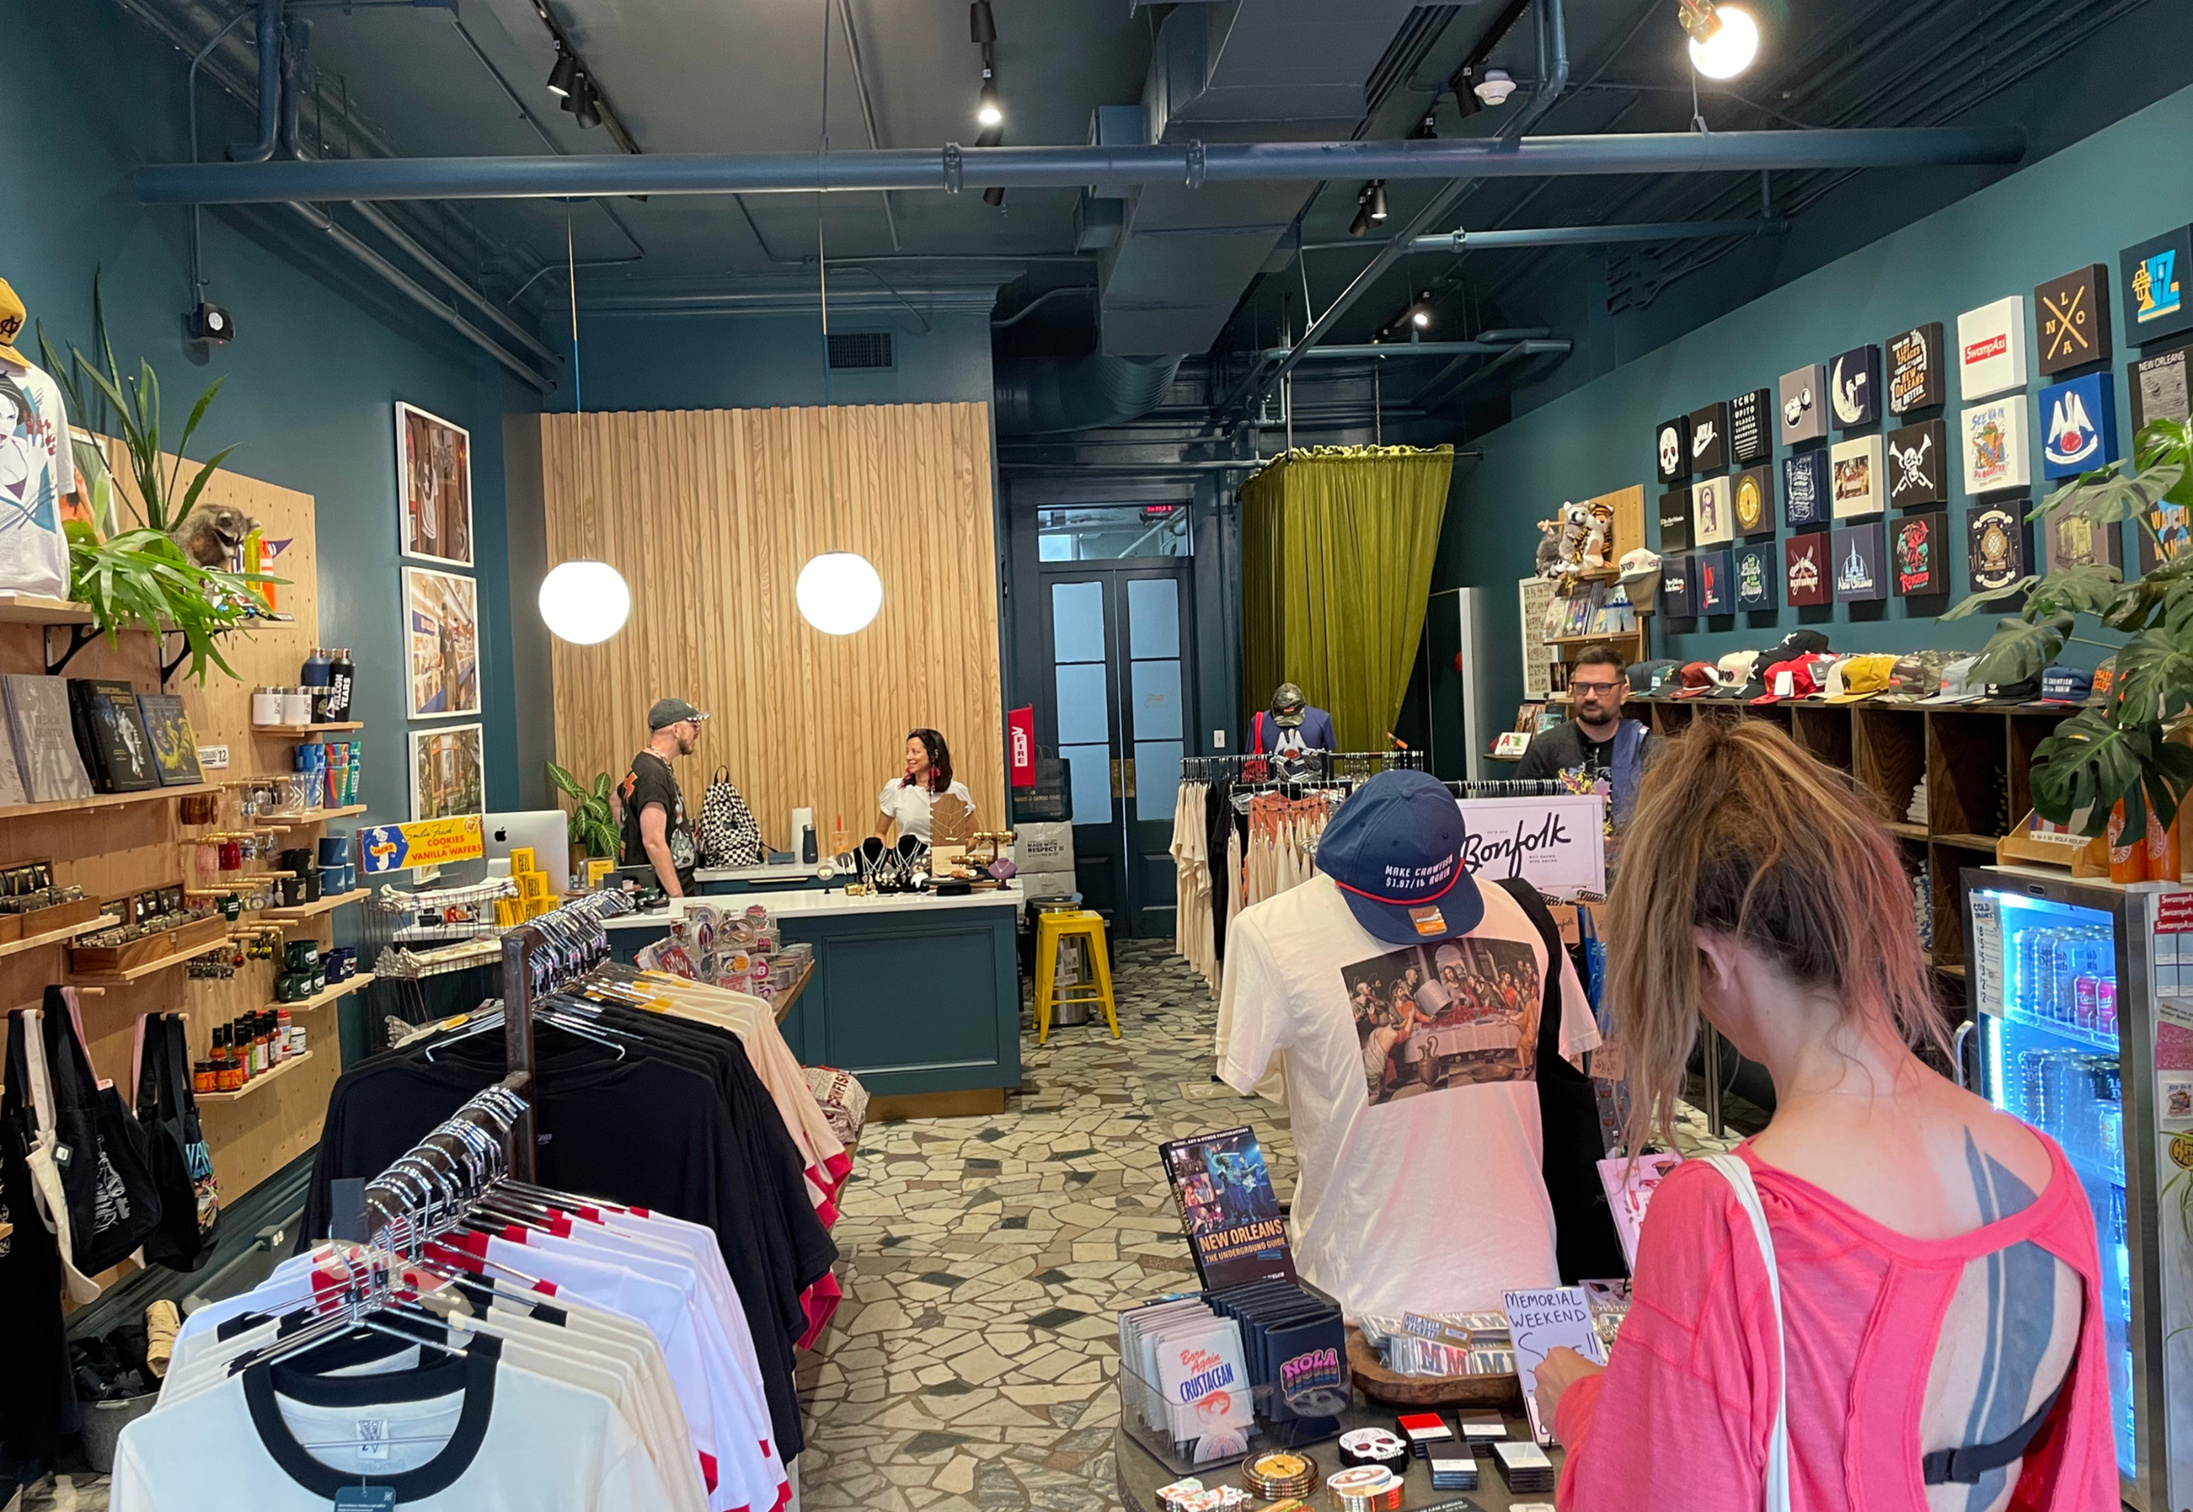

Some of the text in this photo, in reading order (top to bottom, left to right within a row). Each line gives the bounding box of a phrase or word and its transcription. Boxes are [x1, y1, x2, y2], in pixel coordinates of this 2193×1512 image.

[1966, 336, 2006, 360] SwampAss
[2138, 350, 2186, 372] NEW ORLEANS
[1895, 372, 1925, 399] ORLEANS
[1901, 367, 1917, 384] NEW
[1733, 392, 1756, 408] TCHO
[1971, 412, 1987, 431] SEE
[334, 674, 343, 711] FALCON
[341, 677, 351, 708] TEARS
[1016, 736, 1025, 764] FIRE
[411, 844, 482, 861] VANILLA WAFERS
[427, 835, 465, 847] COOKIES
[1463, 812, 1572, 878] Bonfolk
[1385, 853, 1453, 877] MAKE CRAWFISH
[1973, 903, 1991, 912] COLD
[1199, 1219, 1284, 1252] NEW ORLEANS
[1204, 1253, 1218, 1263] THE
[1219, 1241, 1267, 1261] UNDERGROUND
[1267, 1236, 1286, 1247] GUIDE
[1504, 1289, 1583, 1309] MEMORIAL
[1508, 1308, 1587, 1329] WEEKEND
[1180, 1349, 1207, 1366] Born
[1191, 1352, 1222, 1376] Again
[1283, 1350, 1337, 1381] NOLA
[1180, 1363, 1234, 1403] CRUSTACEAN
